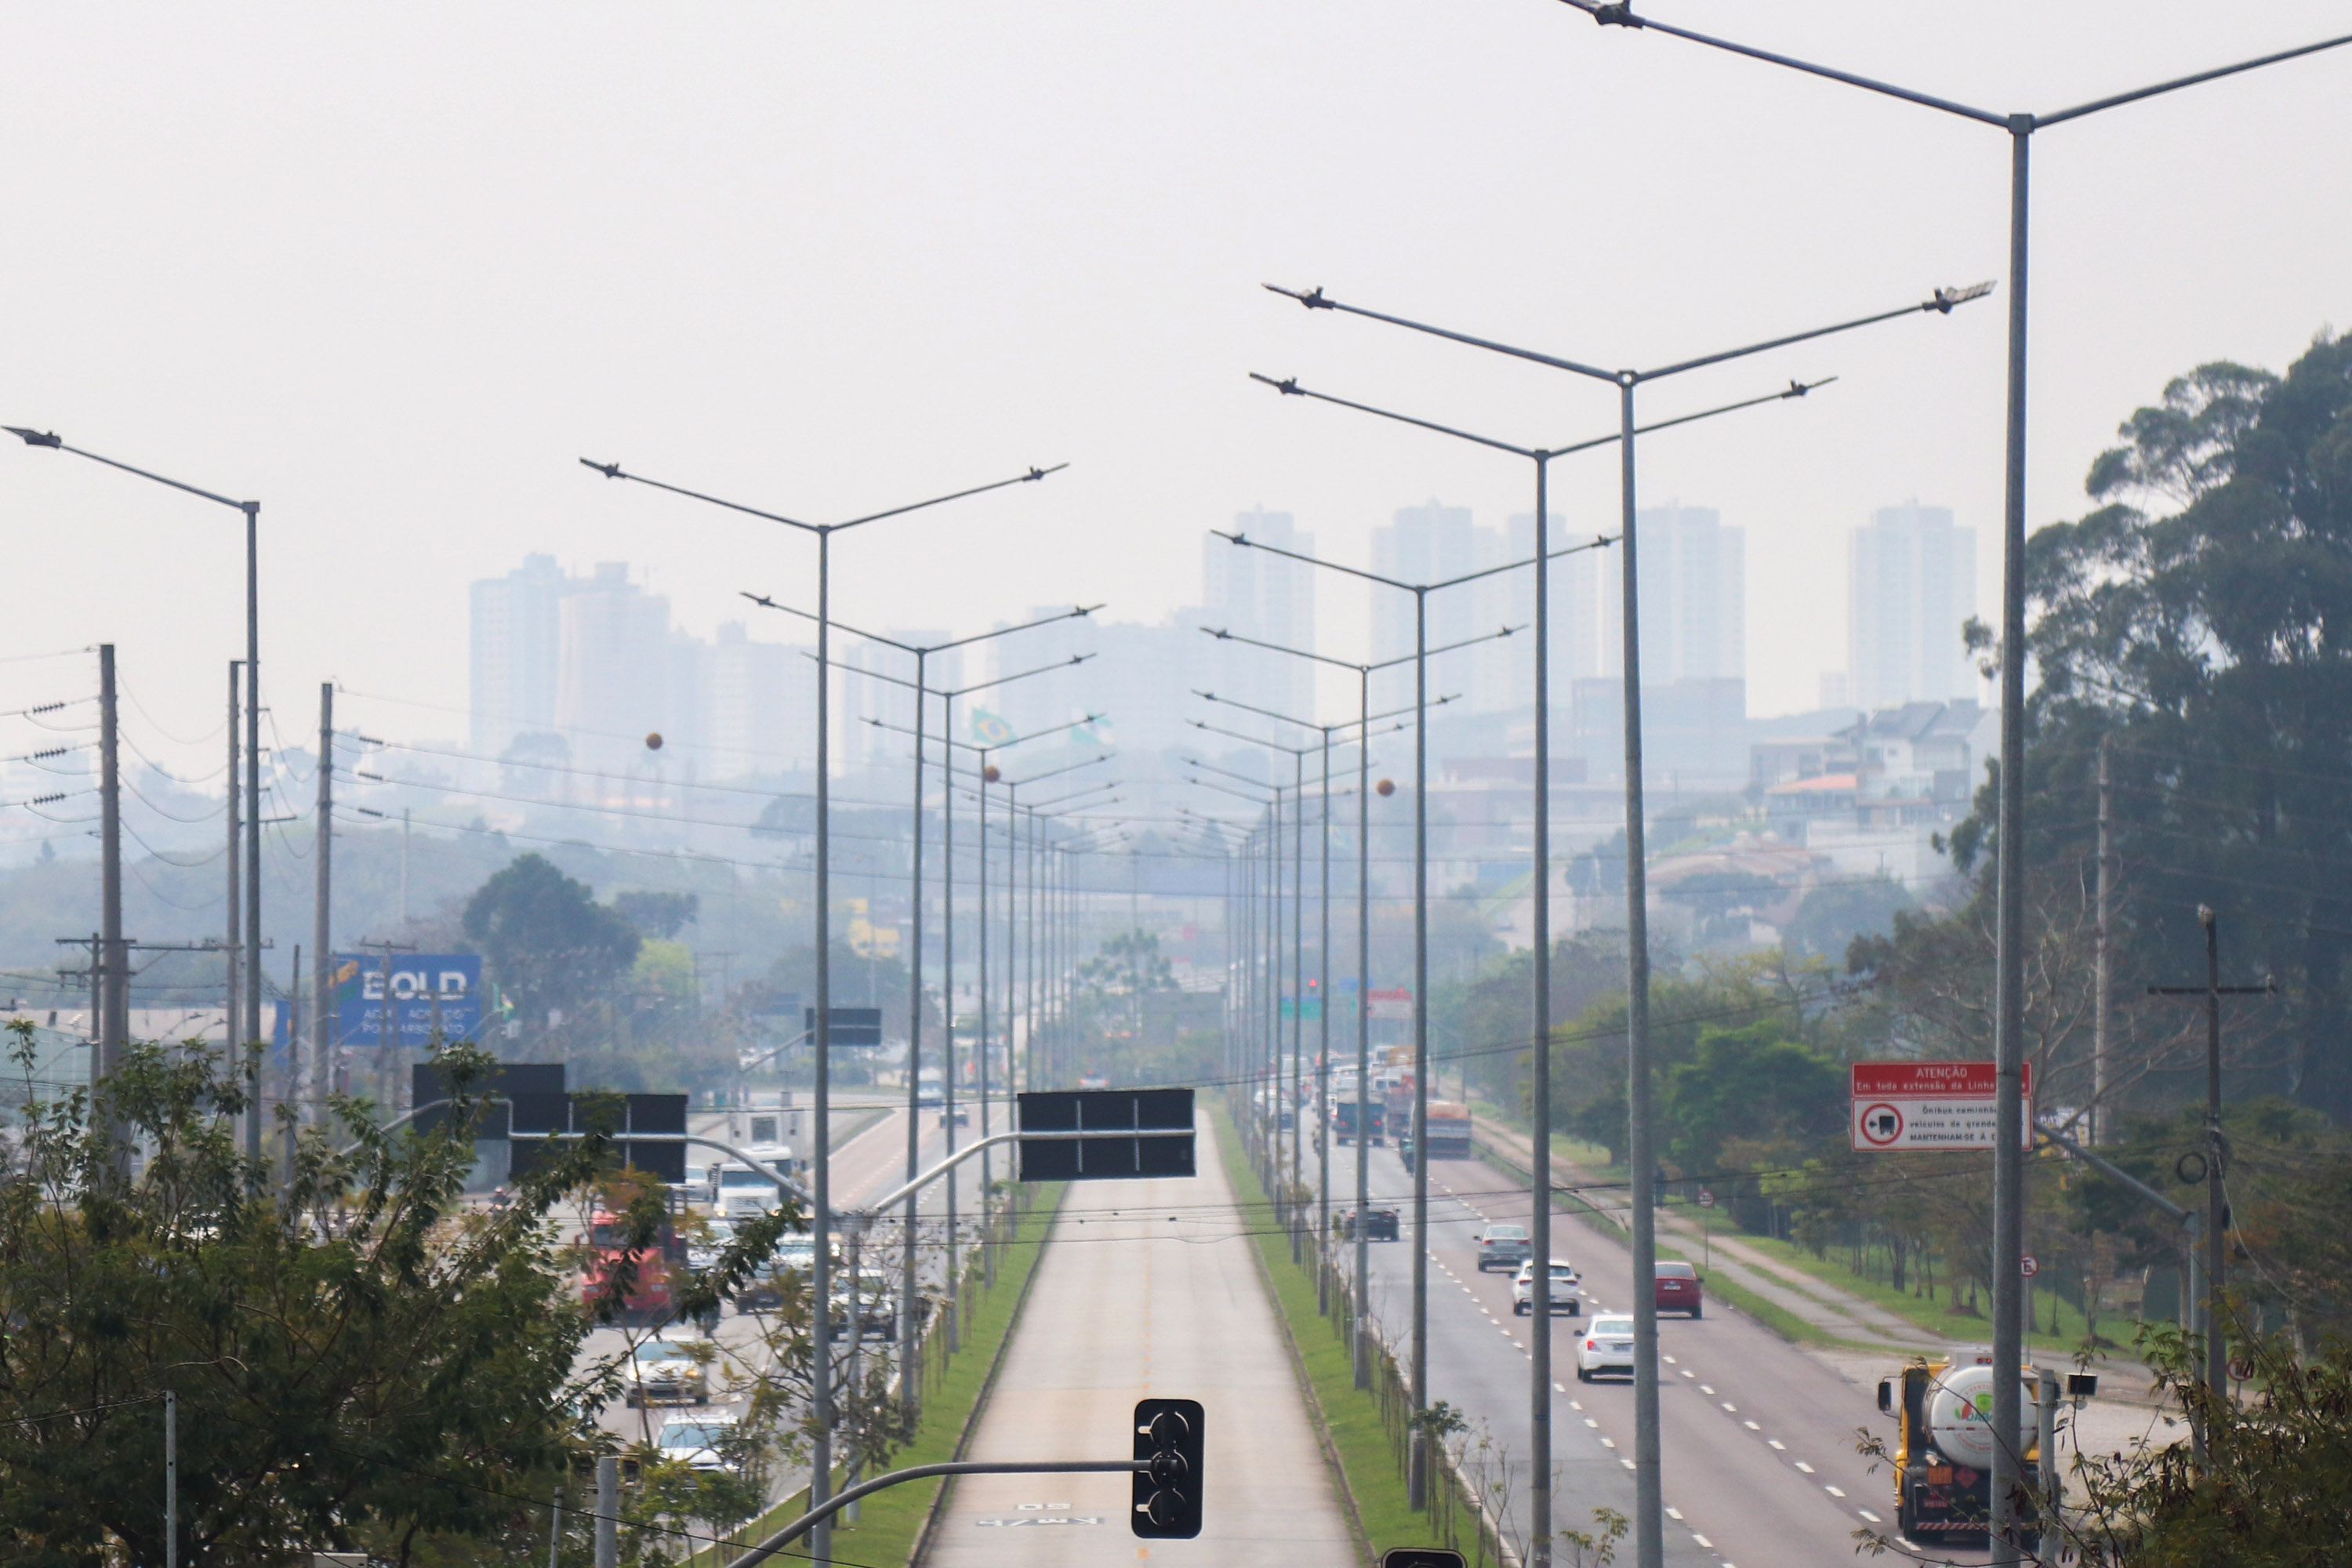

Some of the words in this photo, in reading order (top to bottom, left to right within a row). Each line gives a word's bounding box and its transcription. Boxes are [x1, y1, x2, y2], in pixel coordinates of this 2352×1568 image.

[1917, 1066, 1967, 1080] ATENÇÃO
[1857, 1082, 1871, 1091] Em
[1877, 1082, 1897, 1091] toda
[1904, 1080, 1945, 1091] extensão
